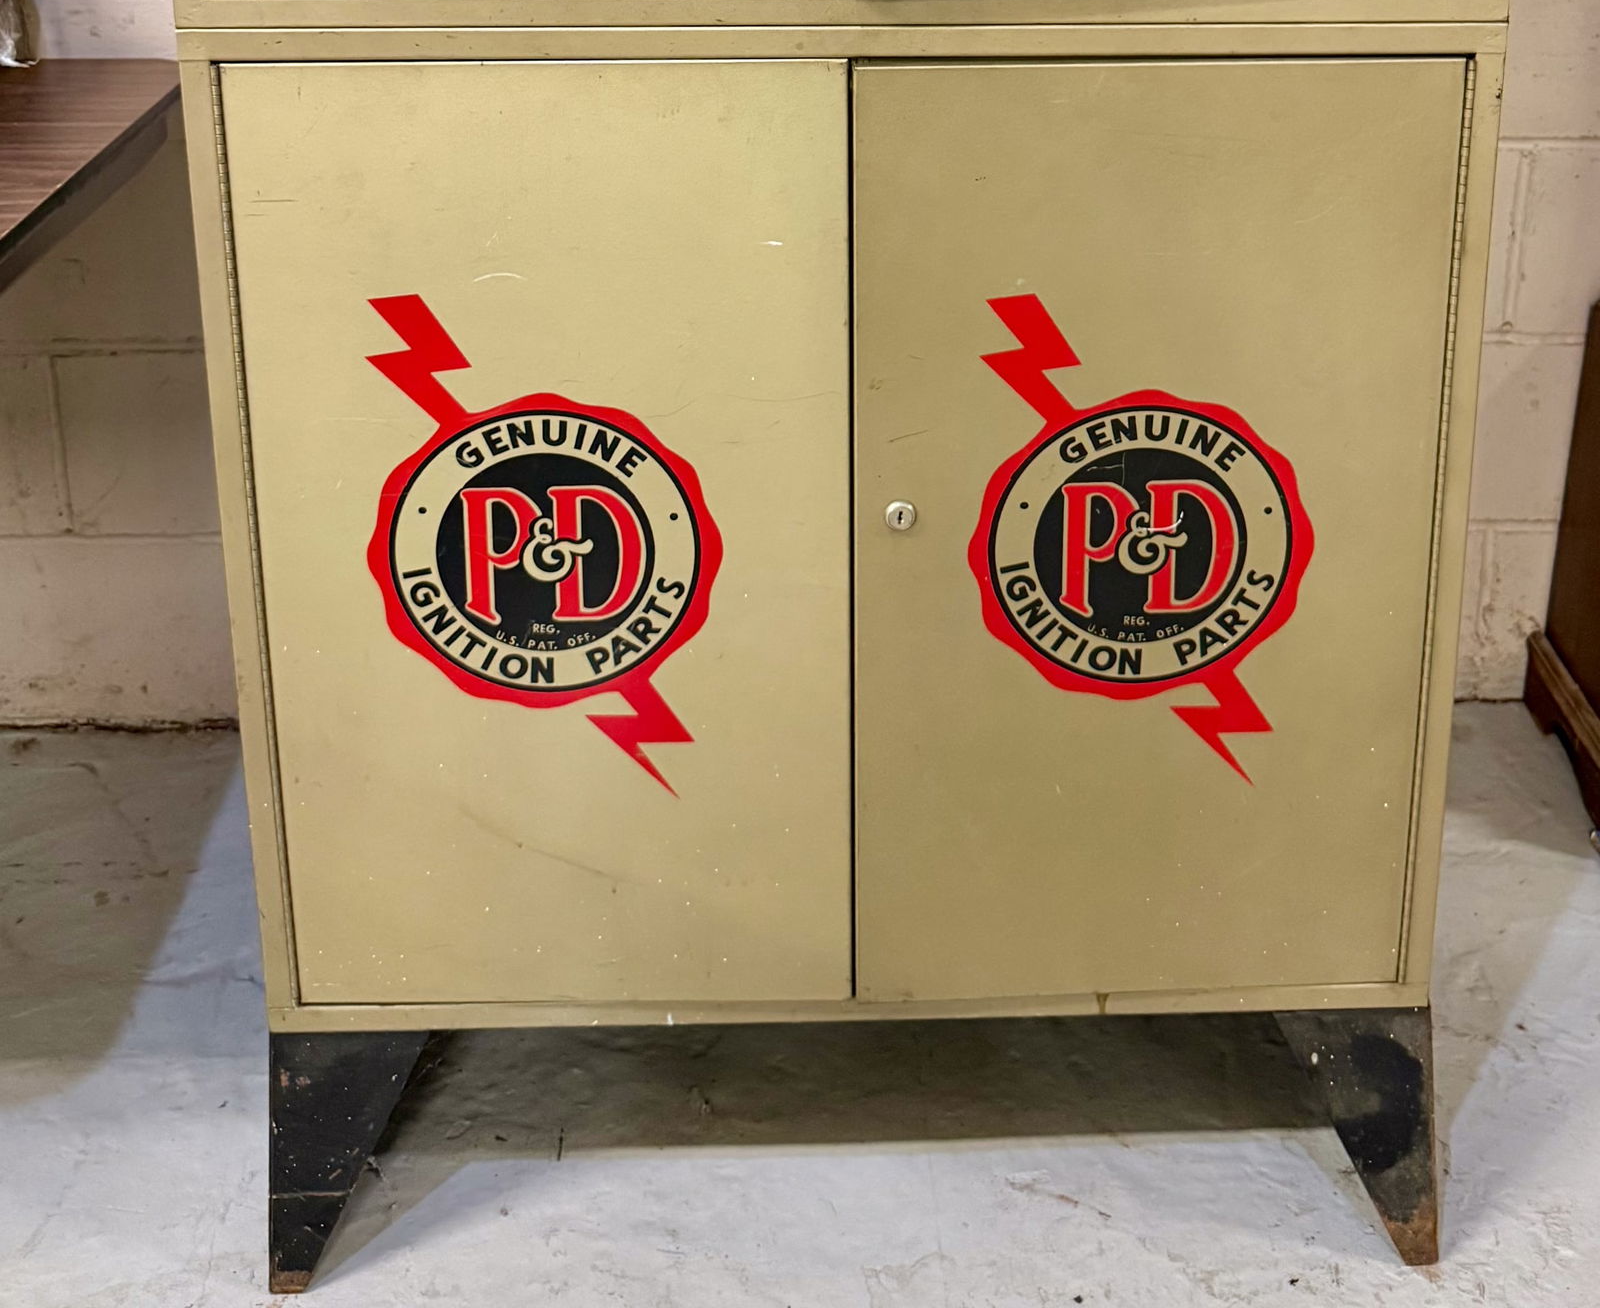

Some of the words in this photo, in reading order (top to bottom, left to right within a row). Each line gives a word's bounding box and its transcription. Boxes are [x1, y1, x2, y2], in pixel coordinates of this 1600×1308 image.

[455, 419, 647, 478] GENUINE
[1059, 415, 1246, 472] GENUINE
[460, 485, 647, 626] P&D
[1059, 479, 1239, 618] P&D
[402, 567, 555, 684] IGNITION
[586, 577, 685, 675] PARTS
[1000, 562, 1143, 675] IGNITION
[1173, 569, 1275, 666] PARTS
